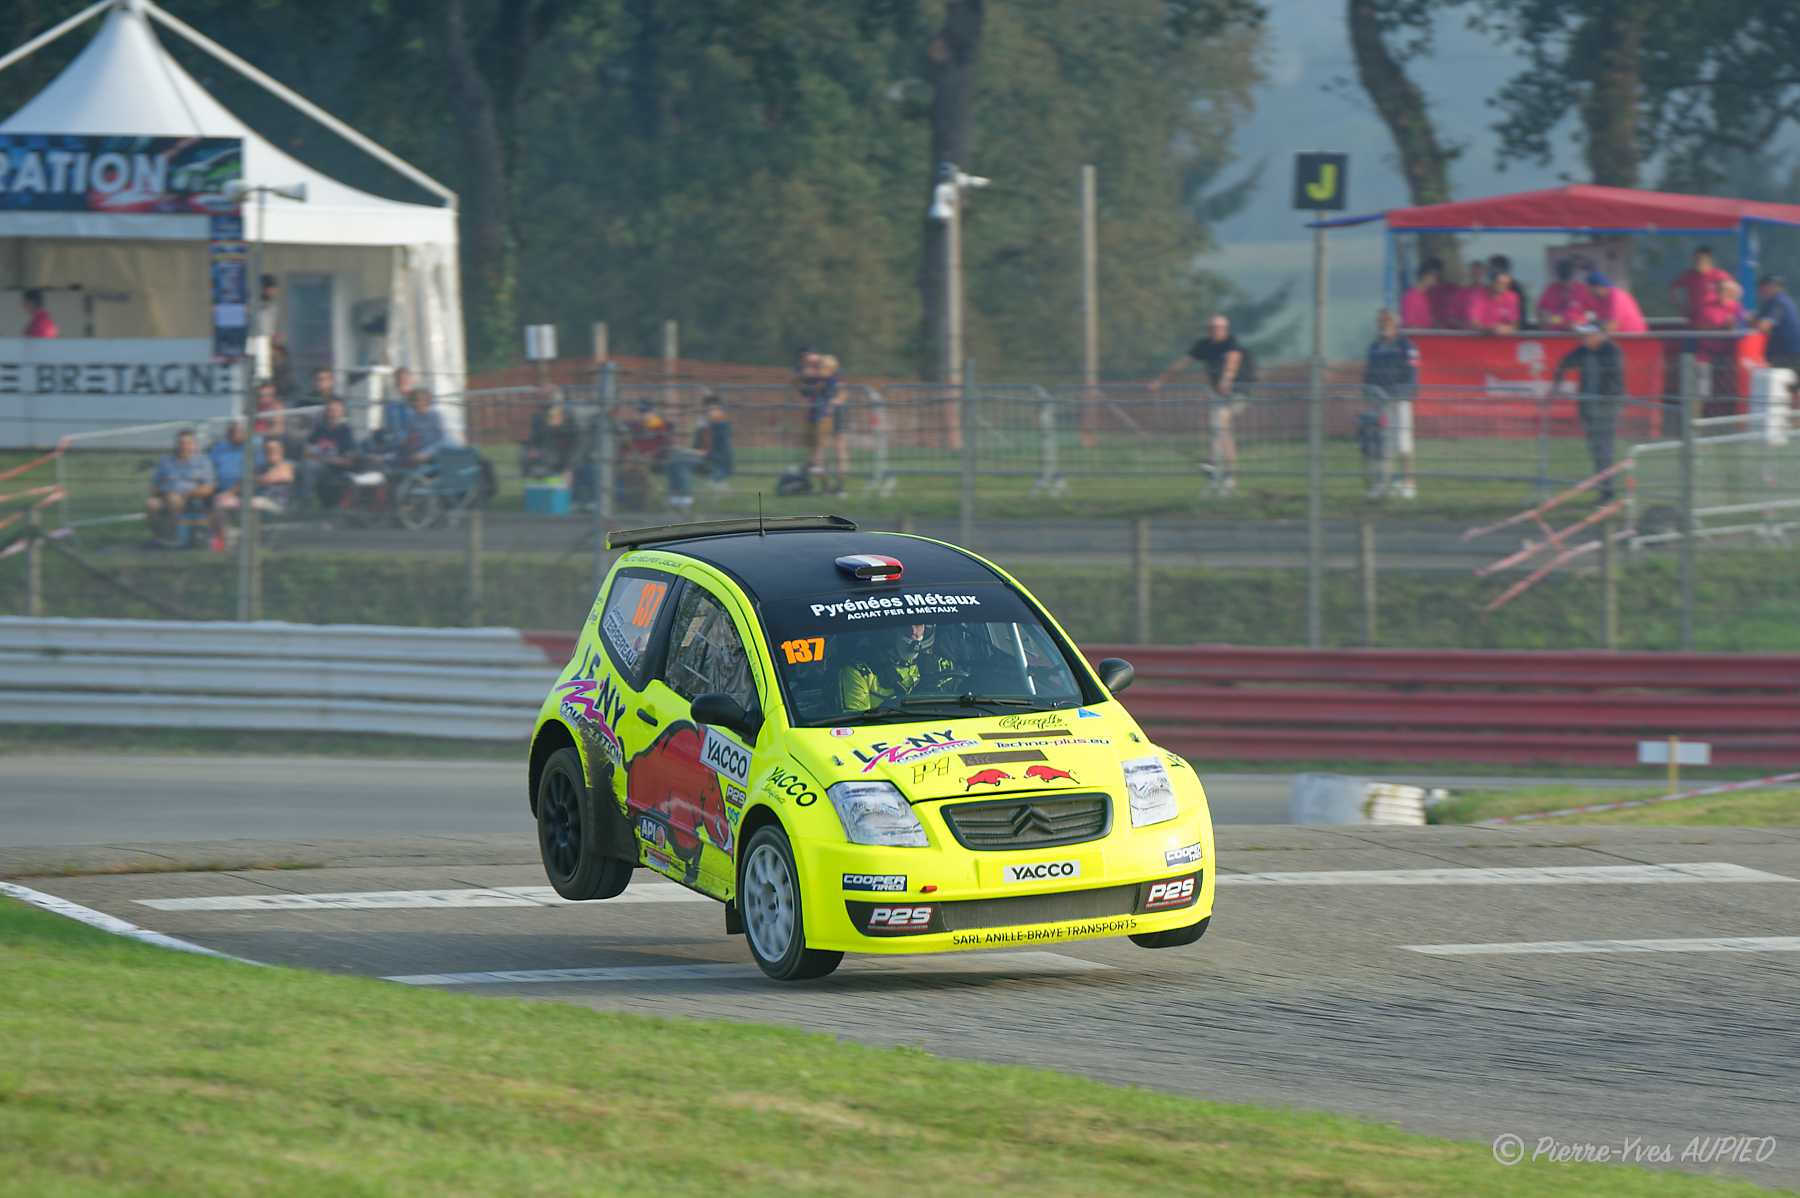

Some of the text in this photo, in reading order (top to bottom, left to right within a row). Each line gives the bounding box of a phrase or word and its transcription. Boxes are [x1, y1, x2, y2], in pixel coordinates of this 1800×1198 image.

[1305, 163, 1336, 200] J
[34, 363, 233, 394] BRETAGNE
[810, 592, 981, 617] Pyrénées Métaux
[847, 611, 881, 621] ACHAT
[884, 608, 905, 617] FER
[906, 607, 915, 615] &
[781, 637, 825, 665] 137
[707, 735, 748, 779] YACCO
[767, 766, 818, 807] YACCO
[843, 875, 906, 885] COOPER
[1011, 863, 1074, 880] YACCO
[1148, 878, 1195, 902] P2S
[870, 907, 932, 924] P2S
[953, 935, 982, 945] SARL
[1067, 919, 1137, 936] TRANSPORTS
